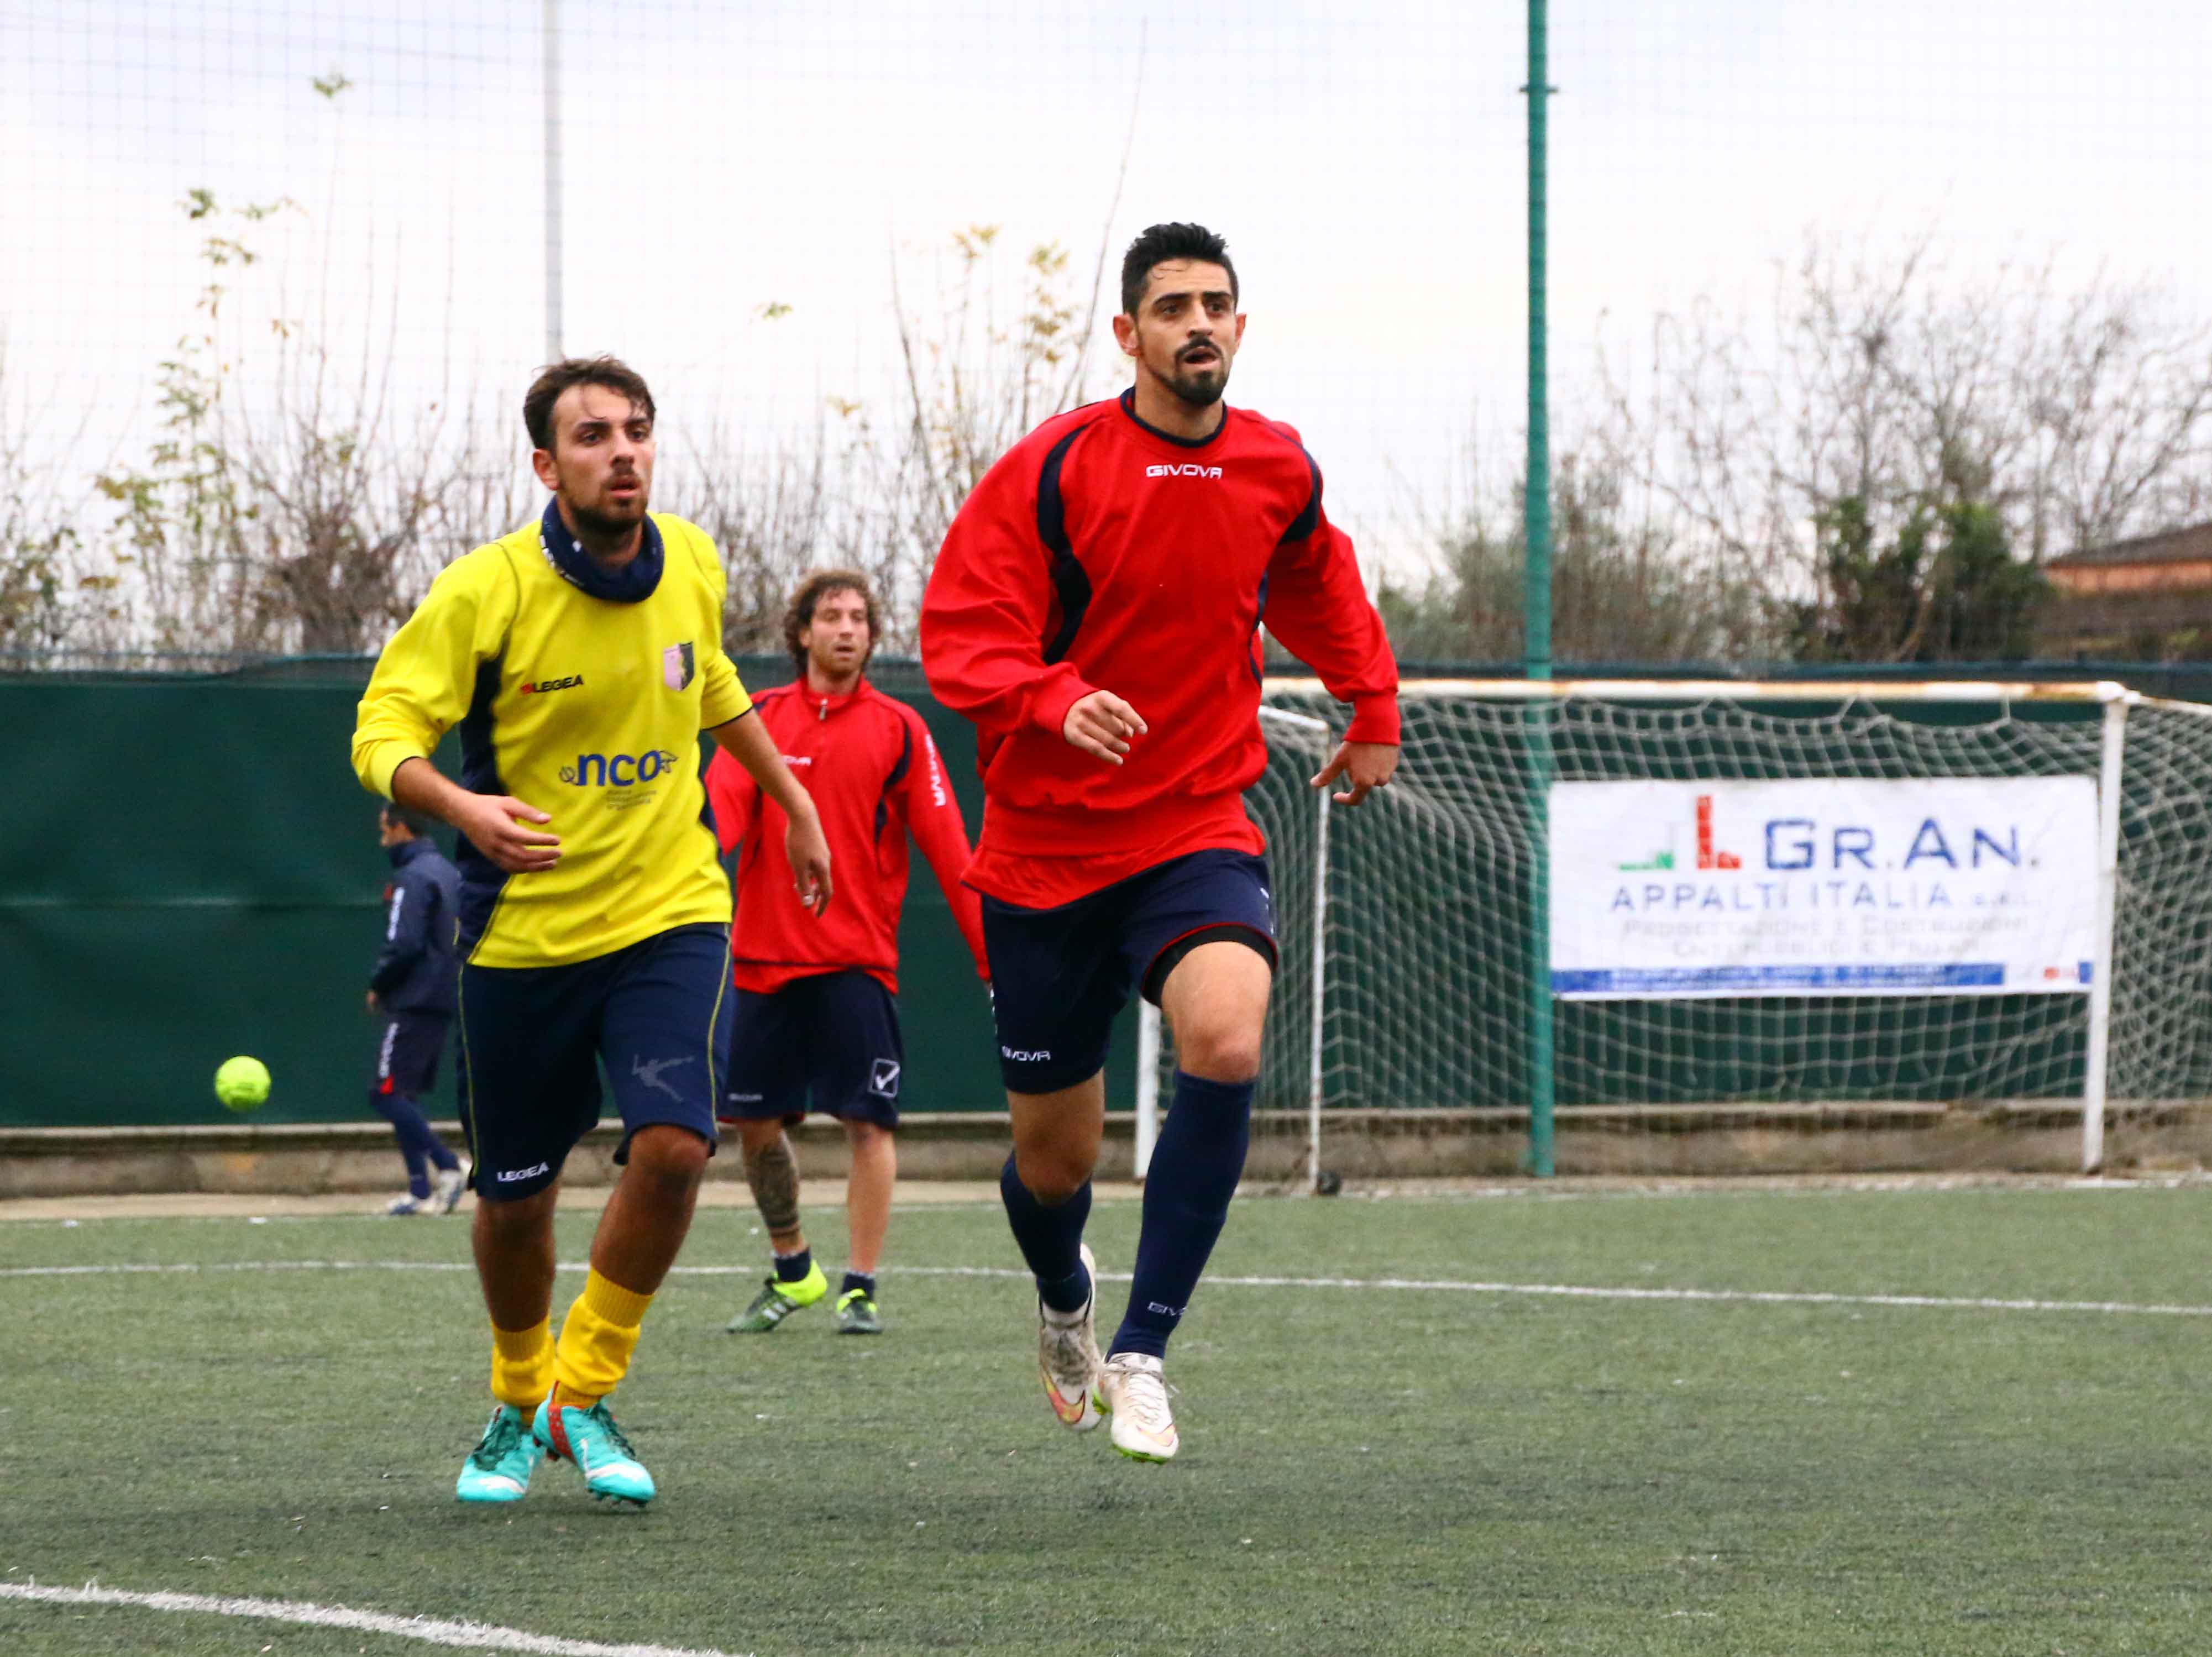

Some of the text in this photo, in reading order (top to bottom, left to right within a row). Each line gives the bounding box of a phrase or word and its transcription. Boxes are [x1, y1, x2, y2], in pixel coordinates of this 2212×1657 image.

[1146, 463, 1223, 480] GIVOVA
[532, 674, 584, 693] LEGEA
[576, 749, 662, 787] nco
[1609, 883, 1789, 911] APPALTI
[1809, 880, 1952, 908] ITALIA
[497, 1161, 549, 1182] LEGEA
